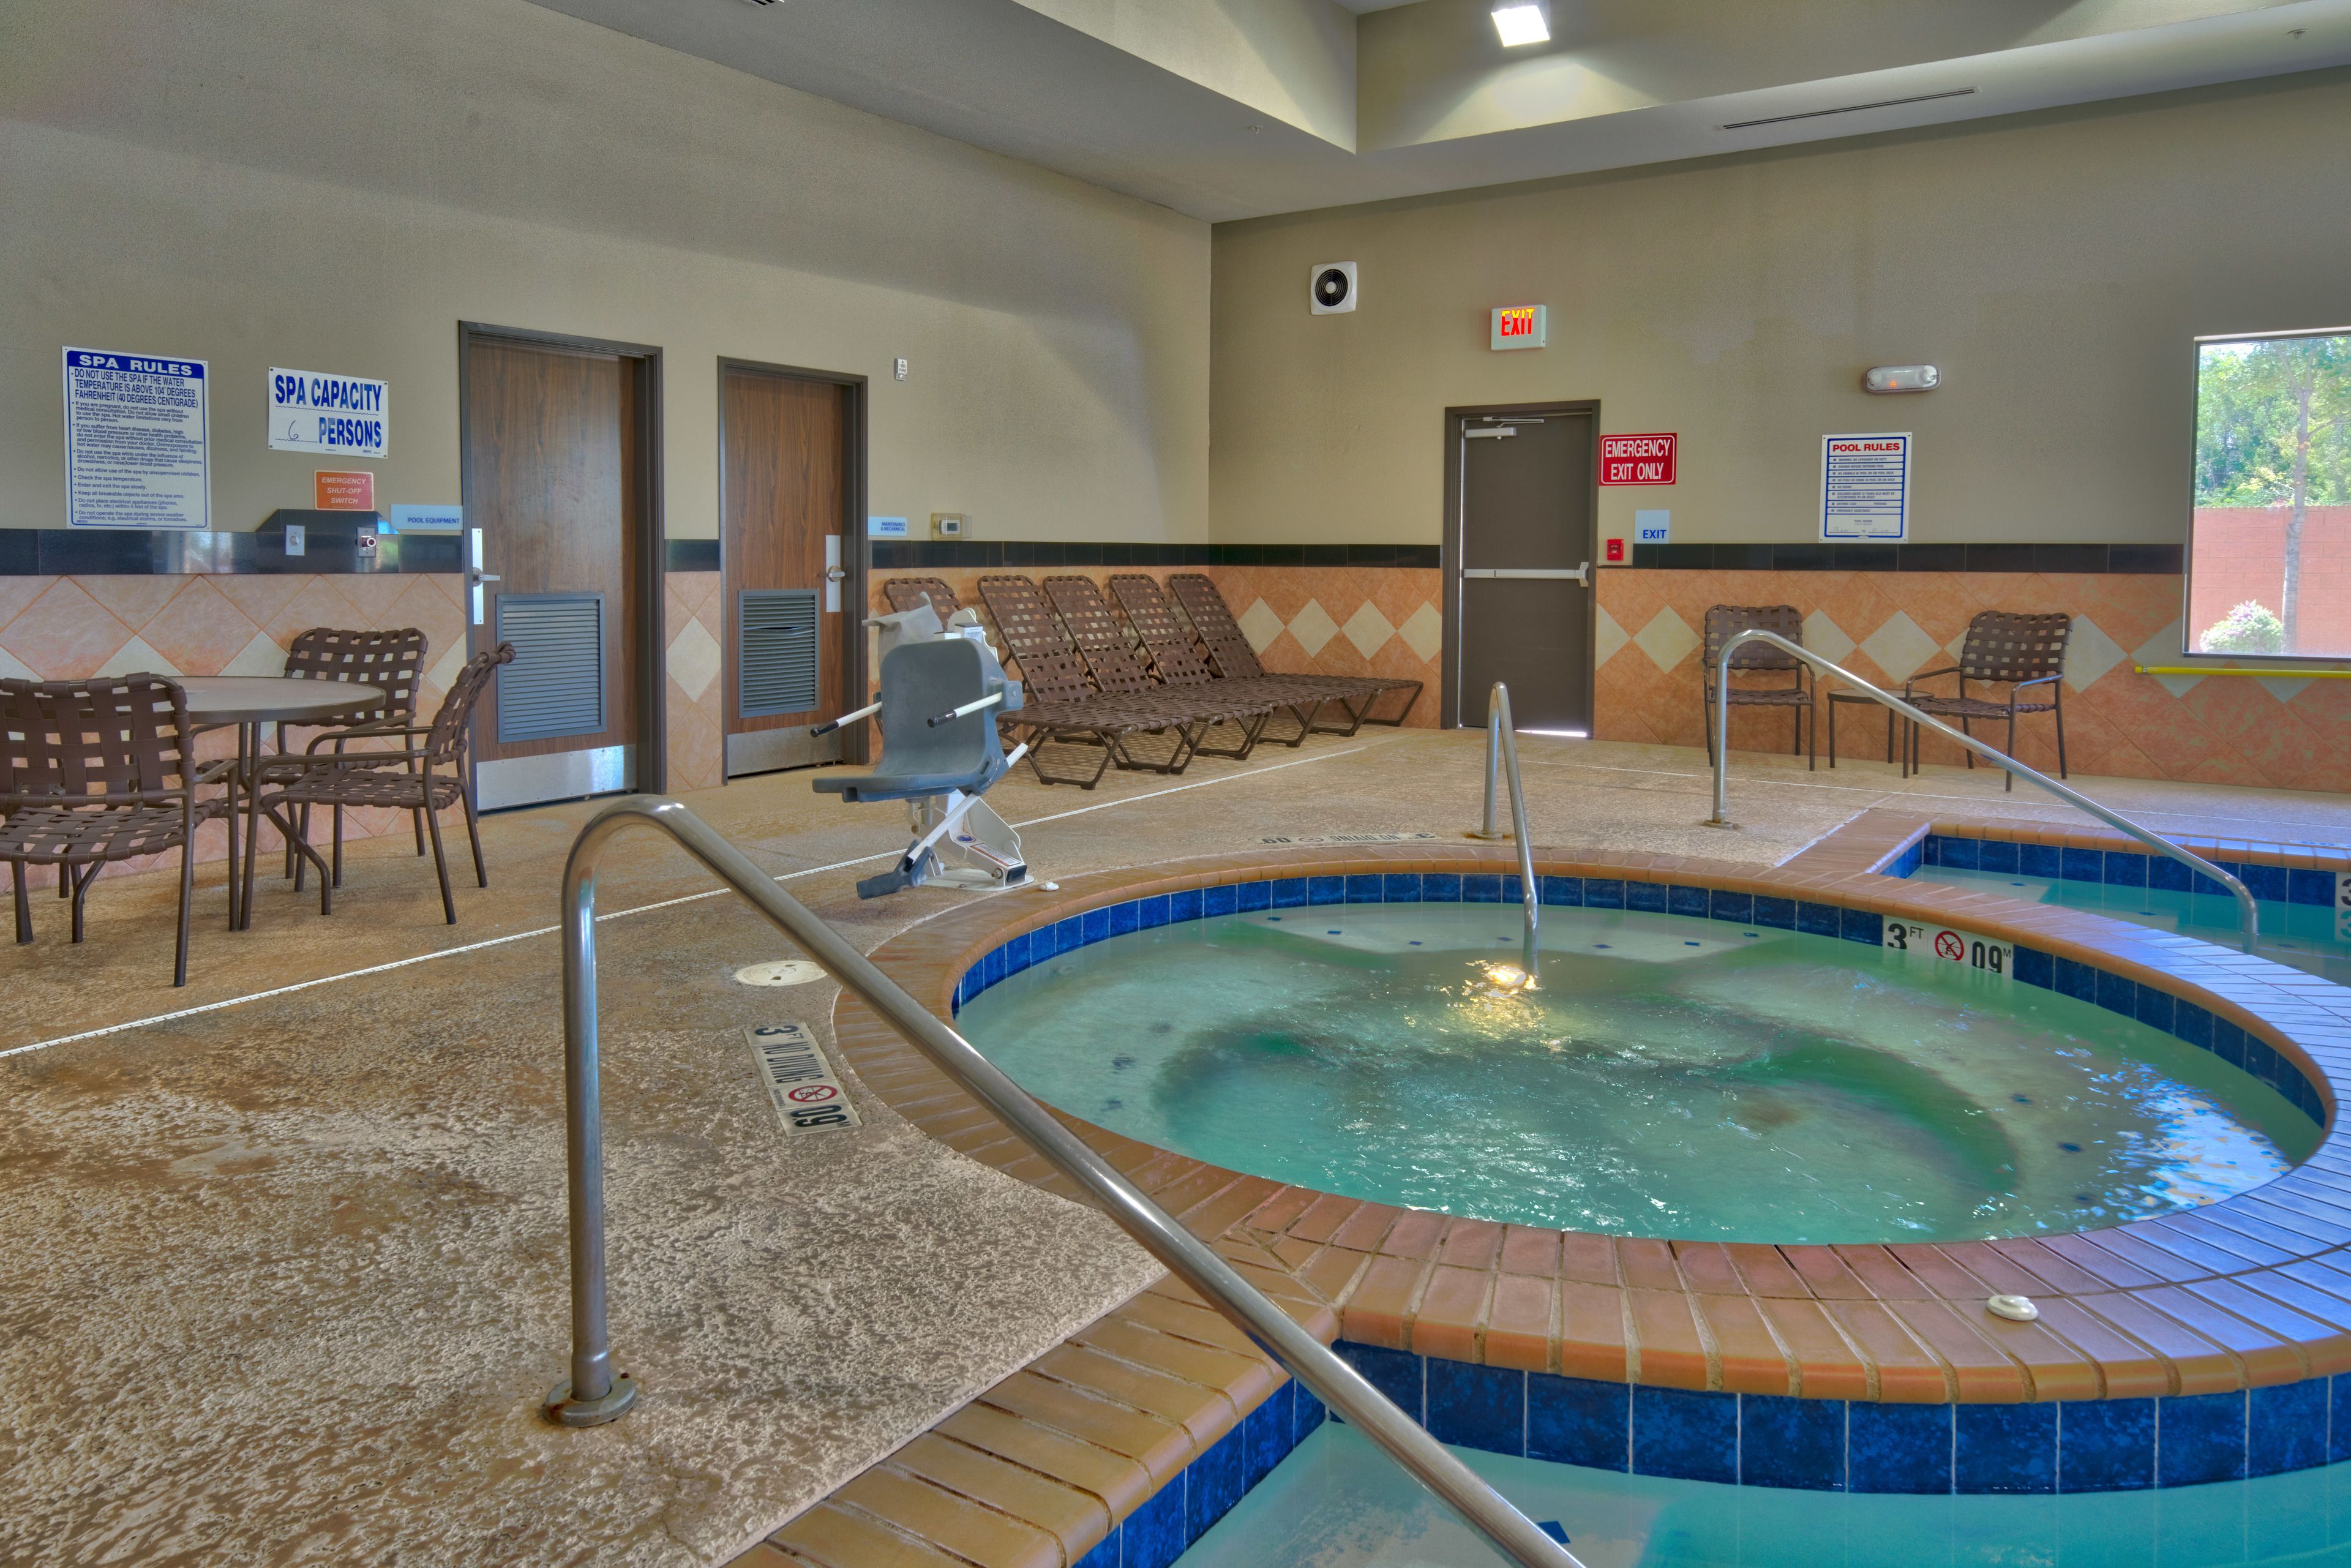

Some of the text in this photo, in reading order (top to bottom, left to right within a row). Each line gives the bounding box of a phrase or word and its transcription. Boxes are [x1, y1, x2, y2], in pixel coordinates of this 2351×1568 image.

[1501, 308, 1534, 336] EXIT
[79, 354, 192, 376] SPA RULES
[74, 369, 184, 386] DO NOT USE THE SPA IF THE WATER
[75, 378, 122, 391] TEMPERATURE
[132, 384, 152, 394] ABOVE
[167, 387, 195, 397] DEGREES
[276, 374, 381, 411] SPA CAPACITY
[75, 389, 198, 408] FAHRENHEIT (40 DEGREES CENTIGRADE)
[288, 420, 299, 440] 6
[318, 416, 381, 448] PERSONS
[1605, 439, 1670, 458] EMERGENCY
[1864, 443, 1900, 451] RULES
[1611, 463, 1664, 480] EXIT ONLY
[1643, 530, 1667, 539] EXIT
[1888, 923, 1907, 950] 3
[1910, 926, 1924, 939] FT
[2003, 948, 2011, 958] M
[754, 1026, 799, 1036] 3
[762, 1041, 811, 1054] NO
[767, 1054, 825, 1084] DIVING
